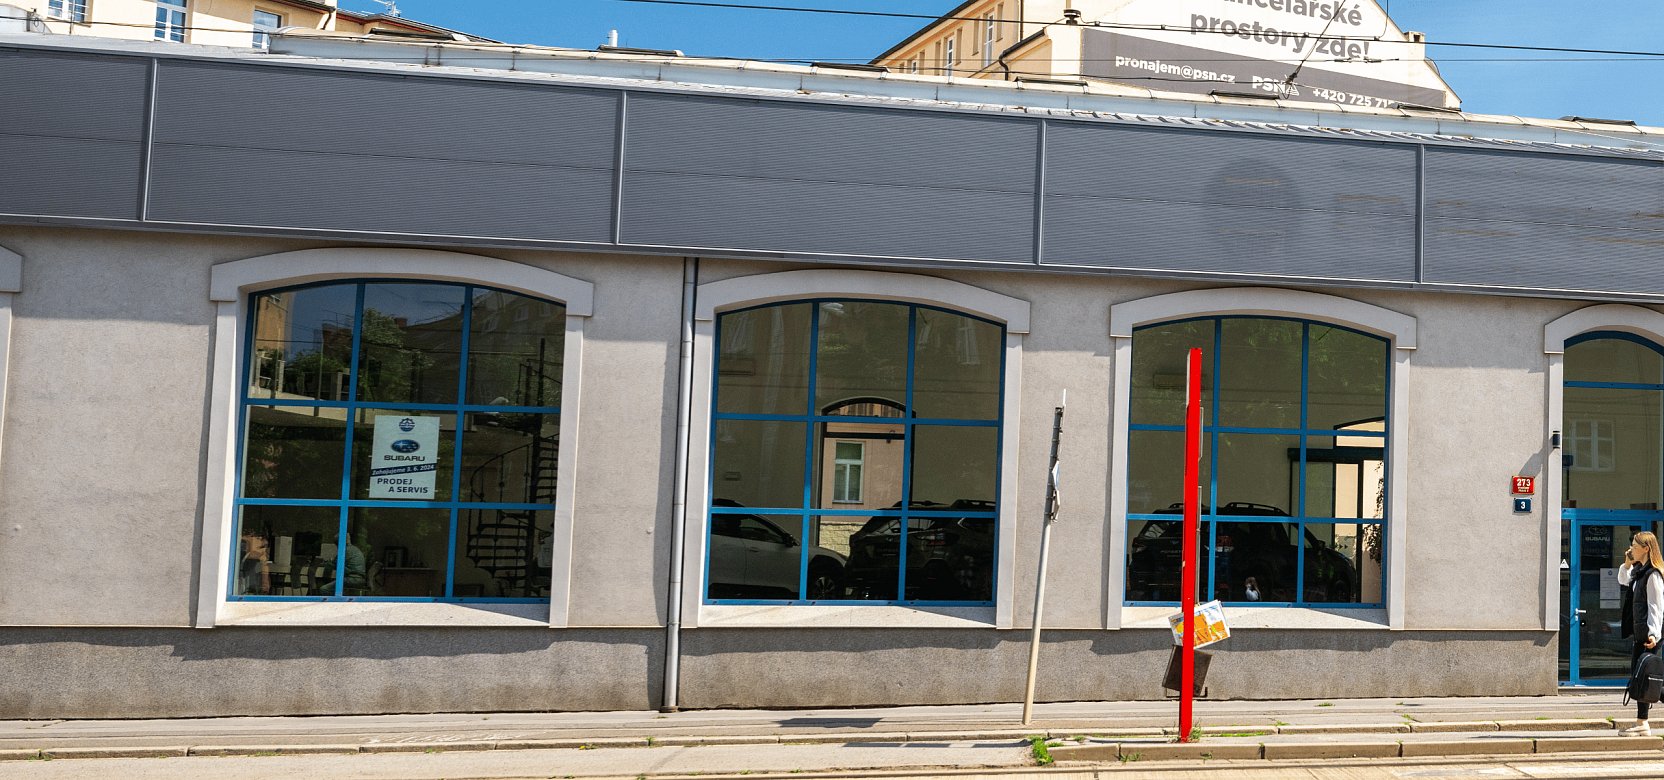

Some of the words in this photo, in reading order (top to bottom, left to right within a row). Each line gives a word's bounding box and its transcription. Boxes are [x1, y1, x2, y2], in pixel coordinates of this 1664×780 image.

[1191, 14, 1306, 53] prostory
[1316, 35, 1370, 60] zde!
[1115, 55, 1236, 84] pronajem@psn.cz
[1313, 88, 1346, 102] +420
[1349, 93, 1372, 107] 725
[1517, 478, 1530, 486] 273
